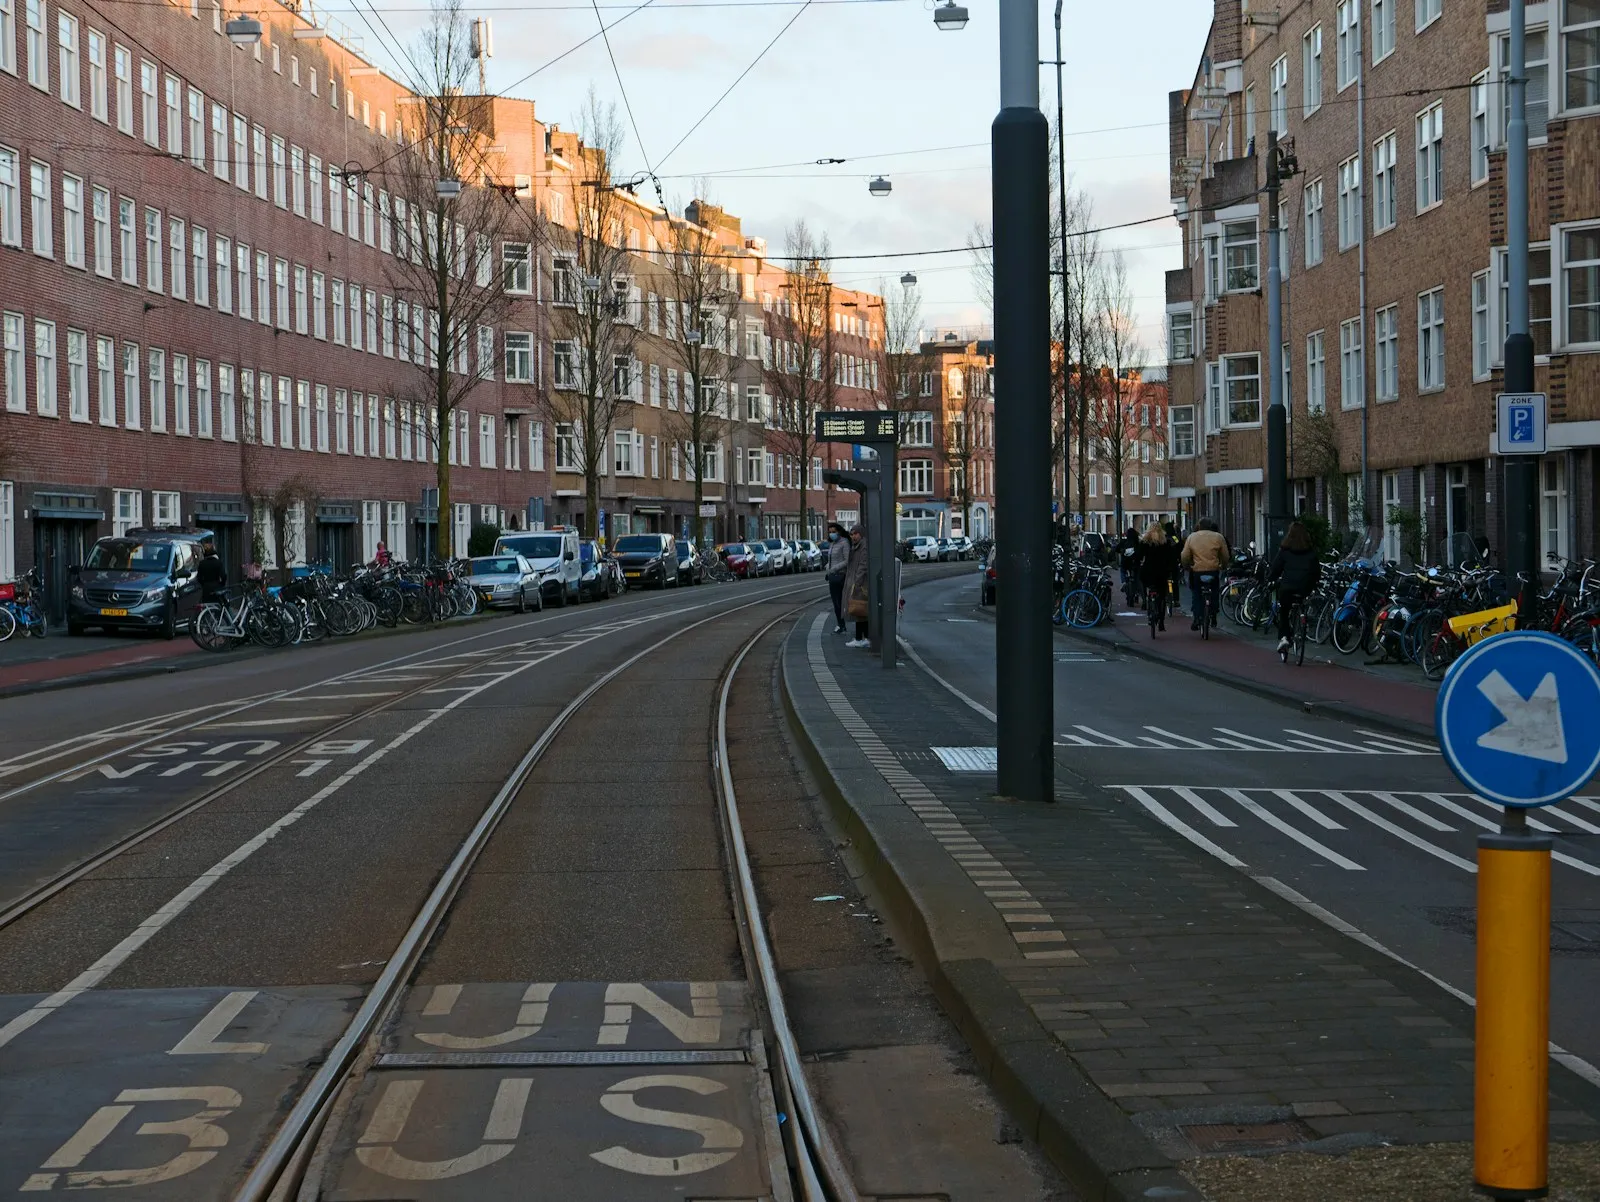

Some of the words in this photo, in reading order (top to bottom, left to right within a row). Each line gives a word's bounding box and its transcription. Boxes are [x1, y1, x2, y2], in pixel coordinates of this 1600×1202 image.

[1514, 409, 1529, 428] P
[127, 739, 375, 757] BUS
[18, 1074, 744, 1192] BUS
